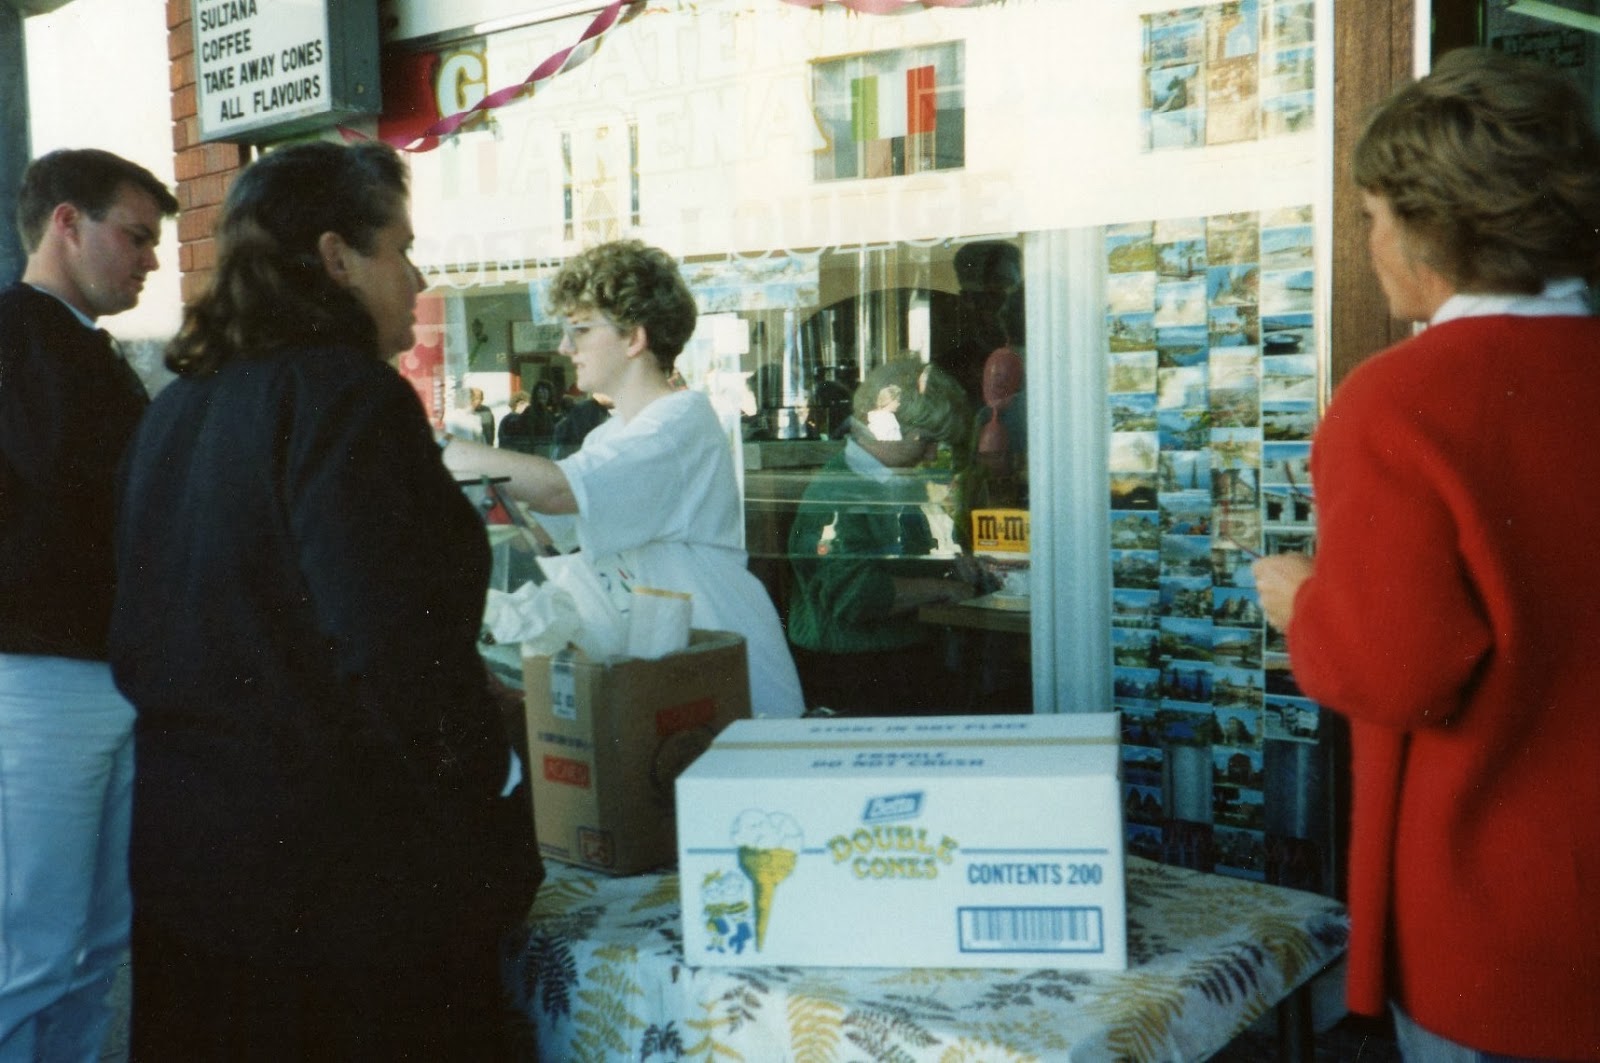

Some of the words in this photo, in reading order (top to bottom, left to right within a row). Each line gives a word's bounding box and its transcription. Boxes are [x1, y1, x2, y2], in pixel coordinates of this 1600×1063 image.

[200, 0, 257, 32] SULTANA
[202, 28, 251, 63] COFFEE
[203, 66, 235, 94] TAKE
[239, 54, 276, 86] AWAY
[280, 39, 324, 73] CONES
[219, 96, 245, 122] ALL
[253, 75, 322, 113] FLAVOURS
[826, 824, 959, 865] DOUBLE
[851, 857, 938, 880] CONES
[967, 863, 1062, 885] CONTENTS
[1067, 863, 1103, 885] 200
